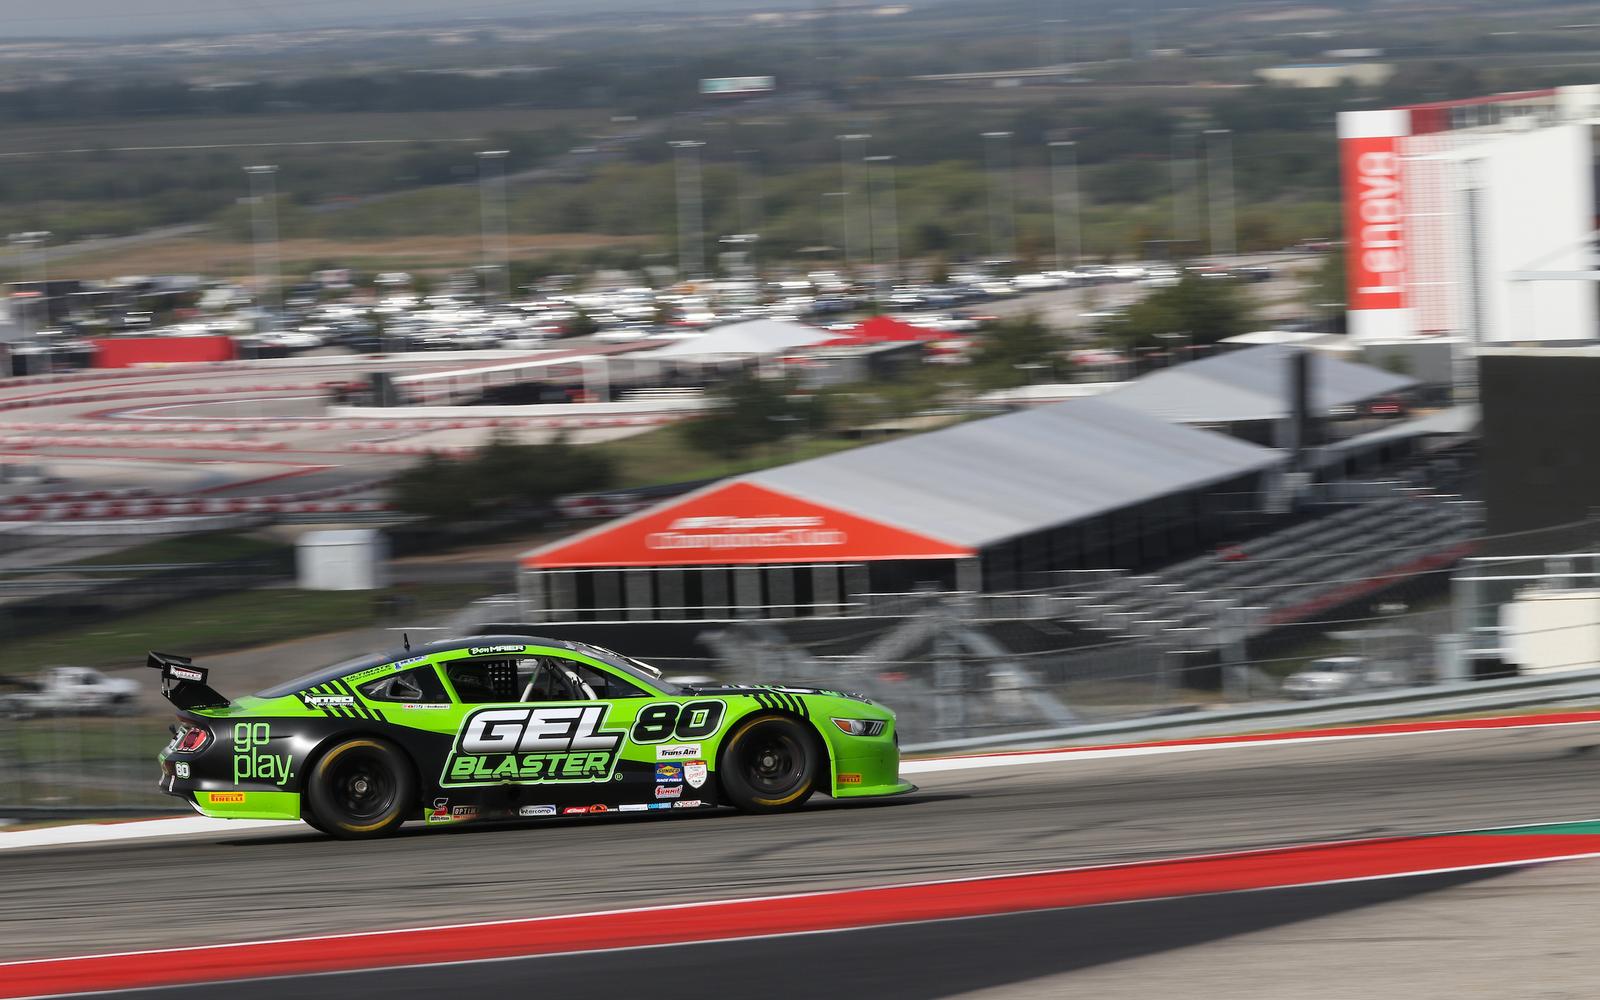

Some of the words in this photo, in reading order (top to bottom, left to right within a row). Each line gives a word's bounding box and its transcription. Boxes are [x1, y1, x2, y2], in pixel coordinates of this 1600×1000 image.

[1357, 151, 1405, 294] Lenovo
[304, 695, 354, 705] NITRO
[462, 707, 618, 752] GEL
[631, 701, 725, 743] 80
[234, 722, 270, 752] go
[175, 762, 190, 778] 80
[234, 747, 294, 785] play.
[451, 752, 611, 779] BLASTER
[839, 774, 860, 782] PIRELLI
[211, 793, 243, 802] PIRELLI
